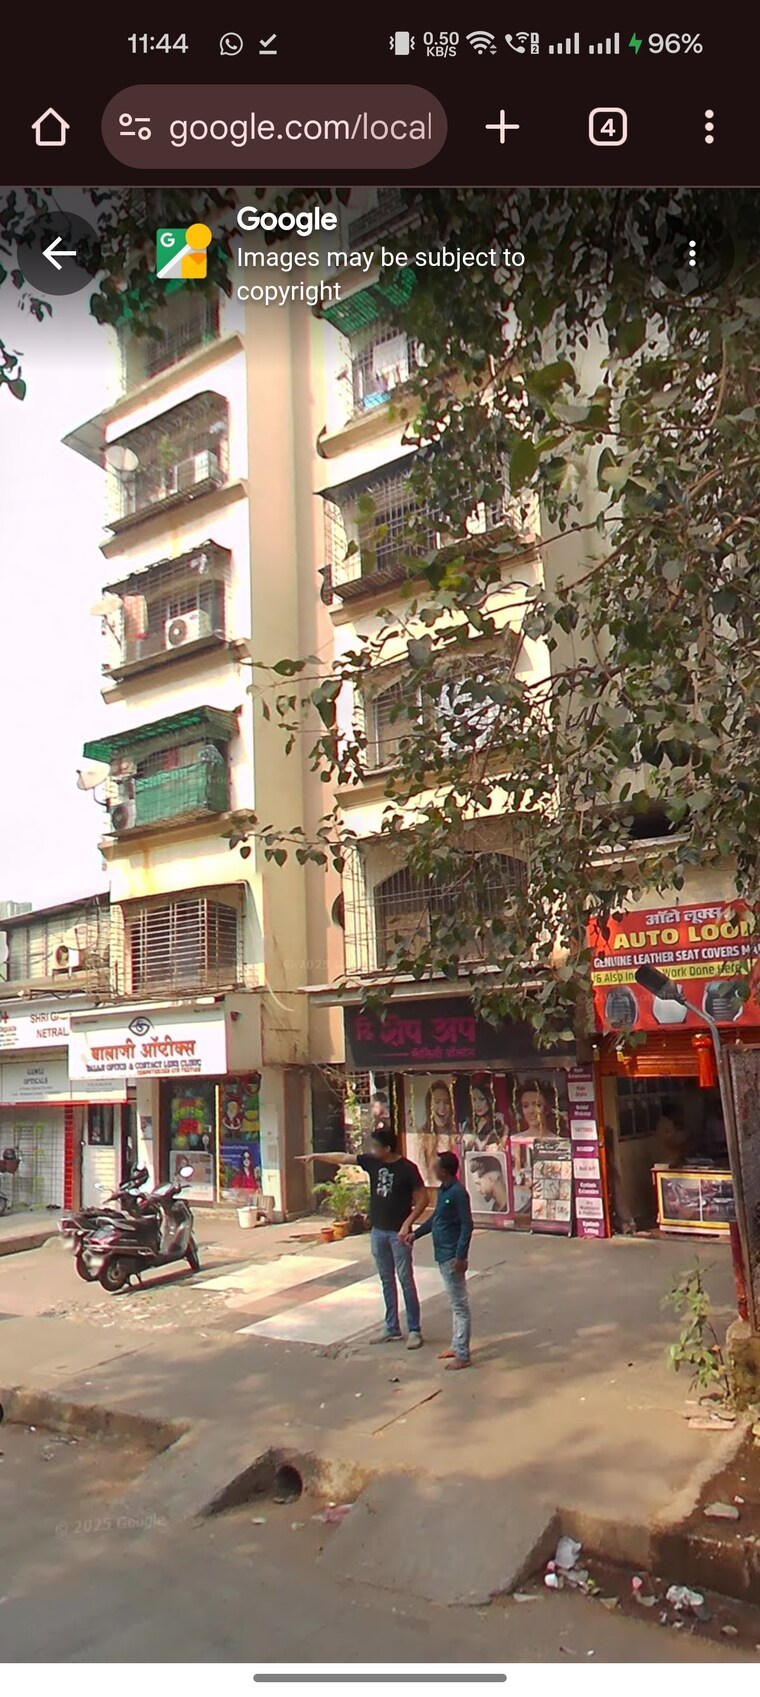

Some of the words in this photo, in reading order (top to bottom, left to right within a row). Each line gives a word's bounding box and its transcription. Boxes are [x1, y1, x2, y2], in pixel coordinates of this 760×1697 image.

[127, 33, 189, 54] 11:44
[423, 31, 460, 45] 0.50
[648, 33, 703, 54] 96%
[426, 46, 457, 58] KB/S
[169, 111, 432, 148] google.com/local
[600, 118, 616, 137] 4
[645, 908, 681, 926] ऑटो
[613, 928, 679, 950] AUTO
[593, 954, 632, 969] GENUINE
[633, 950, 674, 966] LEATHER
[676, 948, 701, 962] SEAT
[701, 945, 740, 959] COVERS
[689, 965, 715, 977] Done
[30, 1012, 49, 1024] SHRI
[90, 1038, 136, 1061] बालाजी
